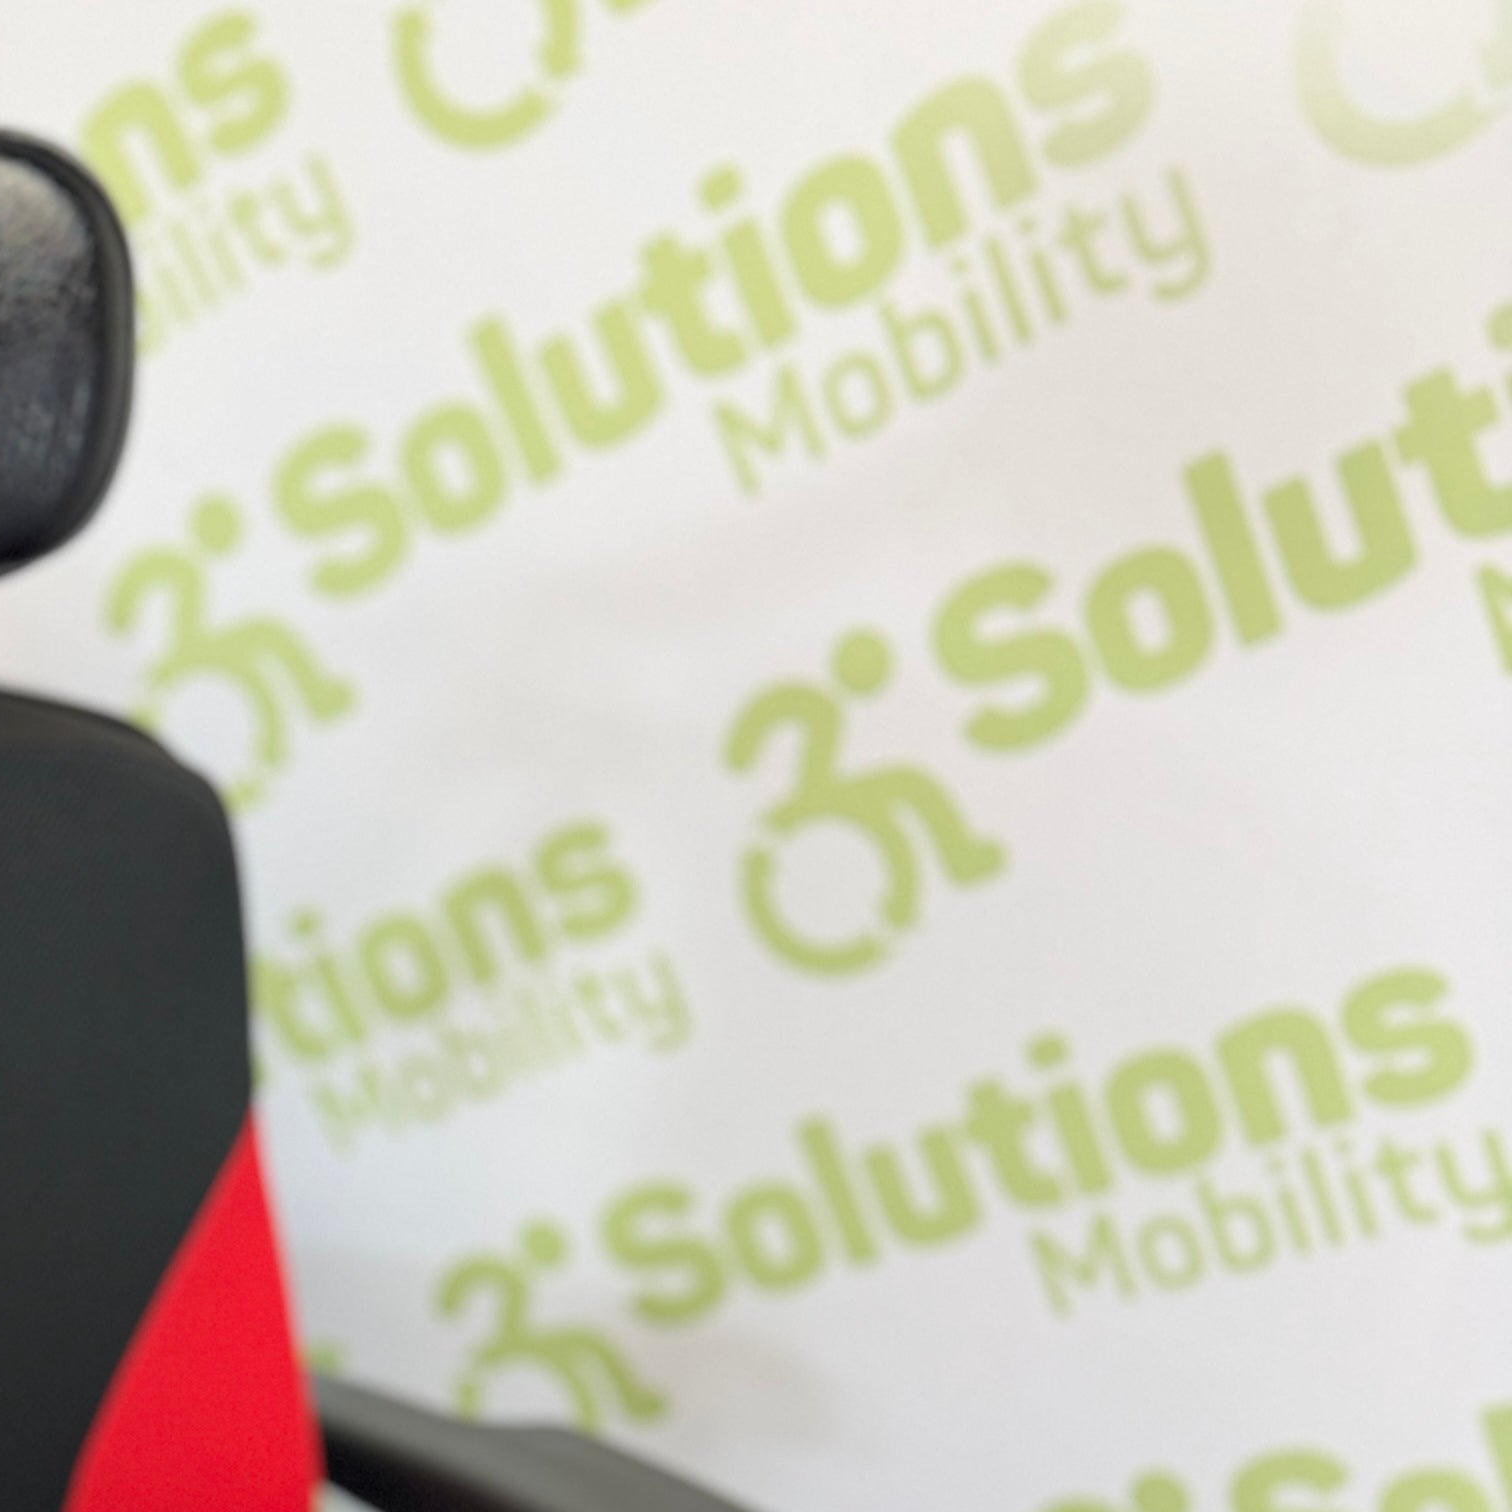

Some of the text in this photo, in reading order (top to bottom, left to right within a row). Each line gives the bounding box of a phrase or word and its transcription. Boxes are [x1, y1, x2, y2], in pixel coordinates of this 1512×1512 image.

[270, 0, 1158, 600] Solutions
[710, 165, 1214, 498] Mobility
[602, 964, 1476, 1326] Solutions
[1028, 1126, 1512, 1318] Mobility
